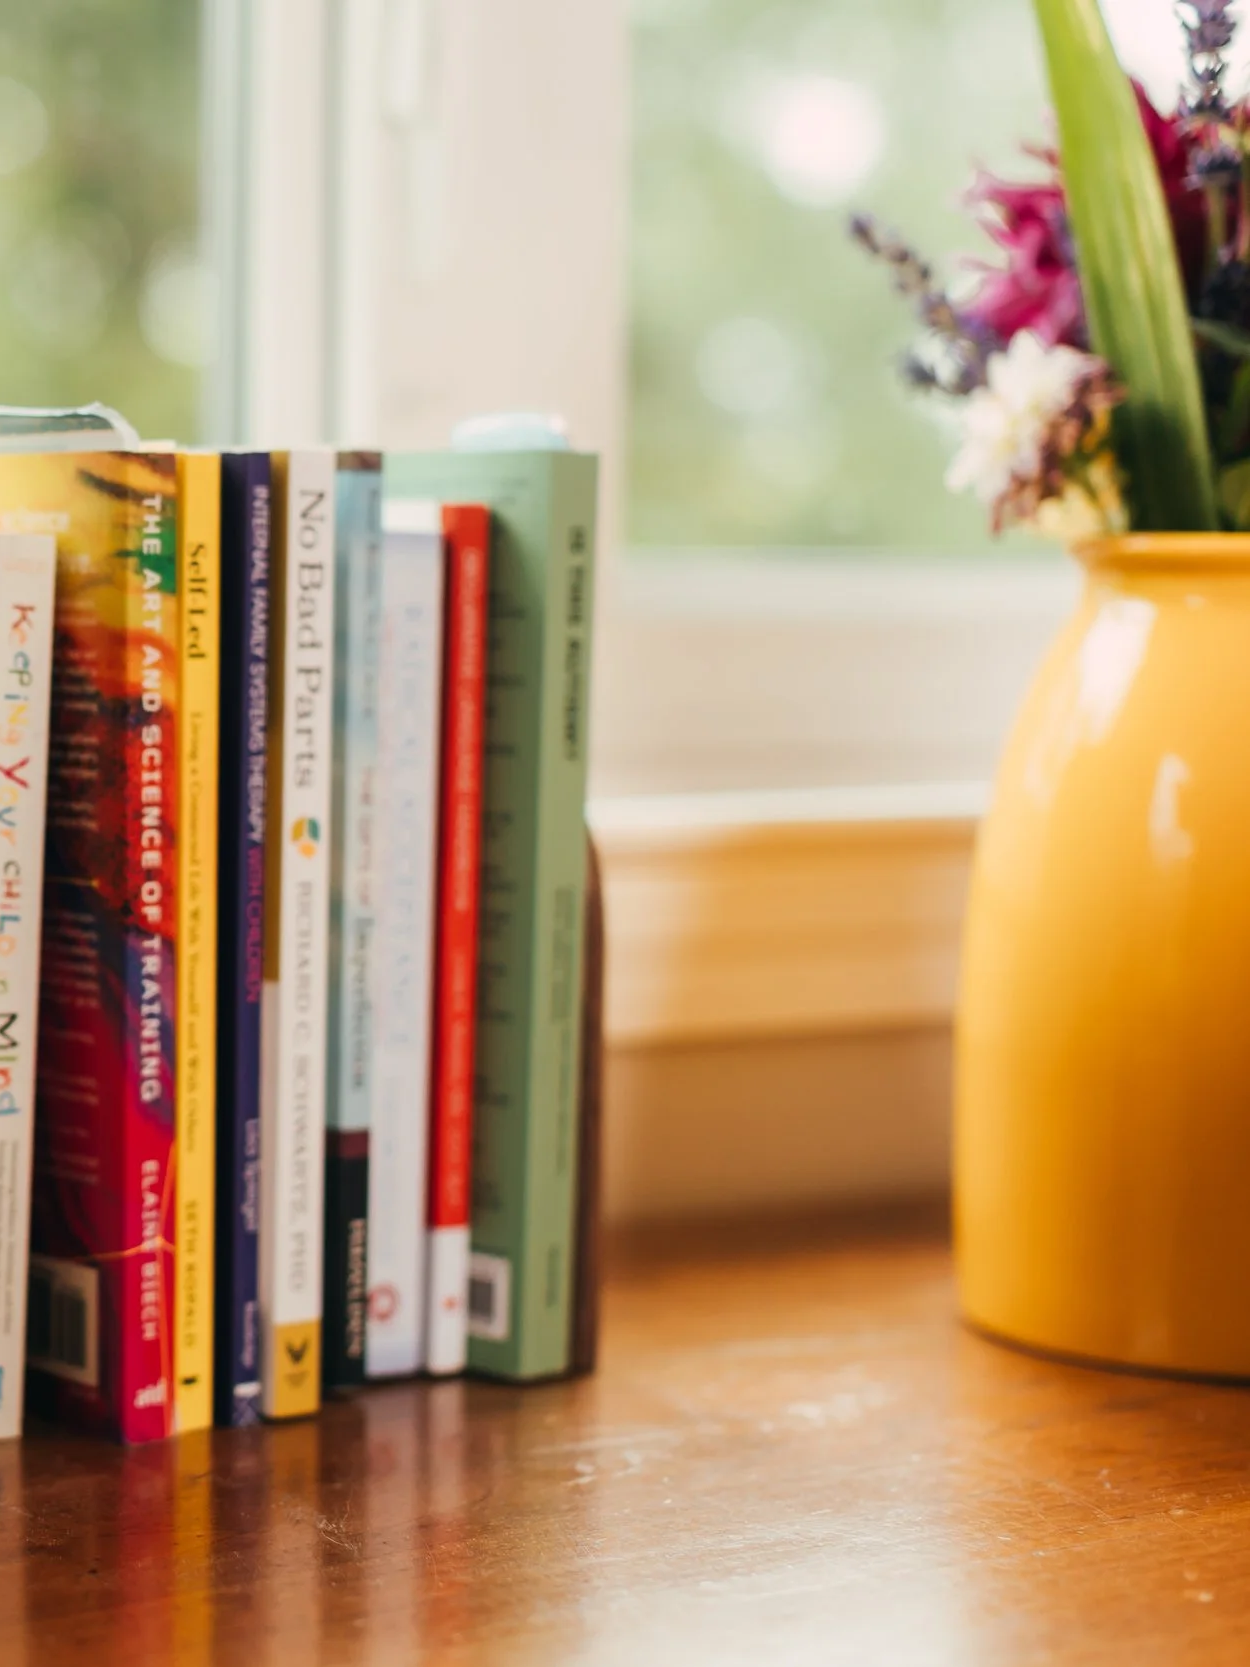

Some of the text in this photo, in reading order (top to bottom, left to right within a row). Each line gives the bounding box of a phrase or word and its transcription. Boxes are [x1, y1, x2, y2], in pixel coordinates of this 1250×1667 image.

[251, 485, 269, 583] INTERNAL
[249, 588, 268, 657] FAMILY
[294, 488, 326, 789] No Bad Parts
[248, 662, 268, 752] SYSTEMS
[140, 494, 162, 1102] THE ART AND SCIENCE OF TRAINING
[247, 757, 266, 844] THERAPY
